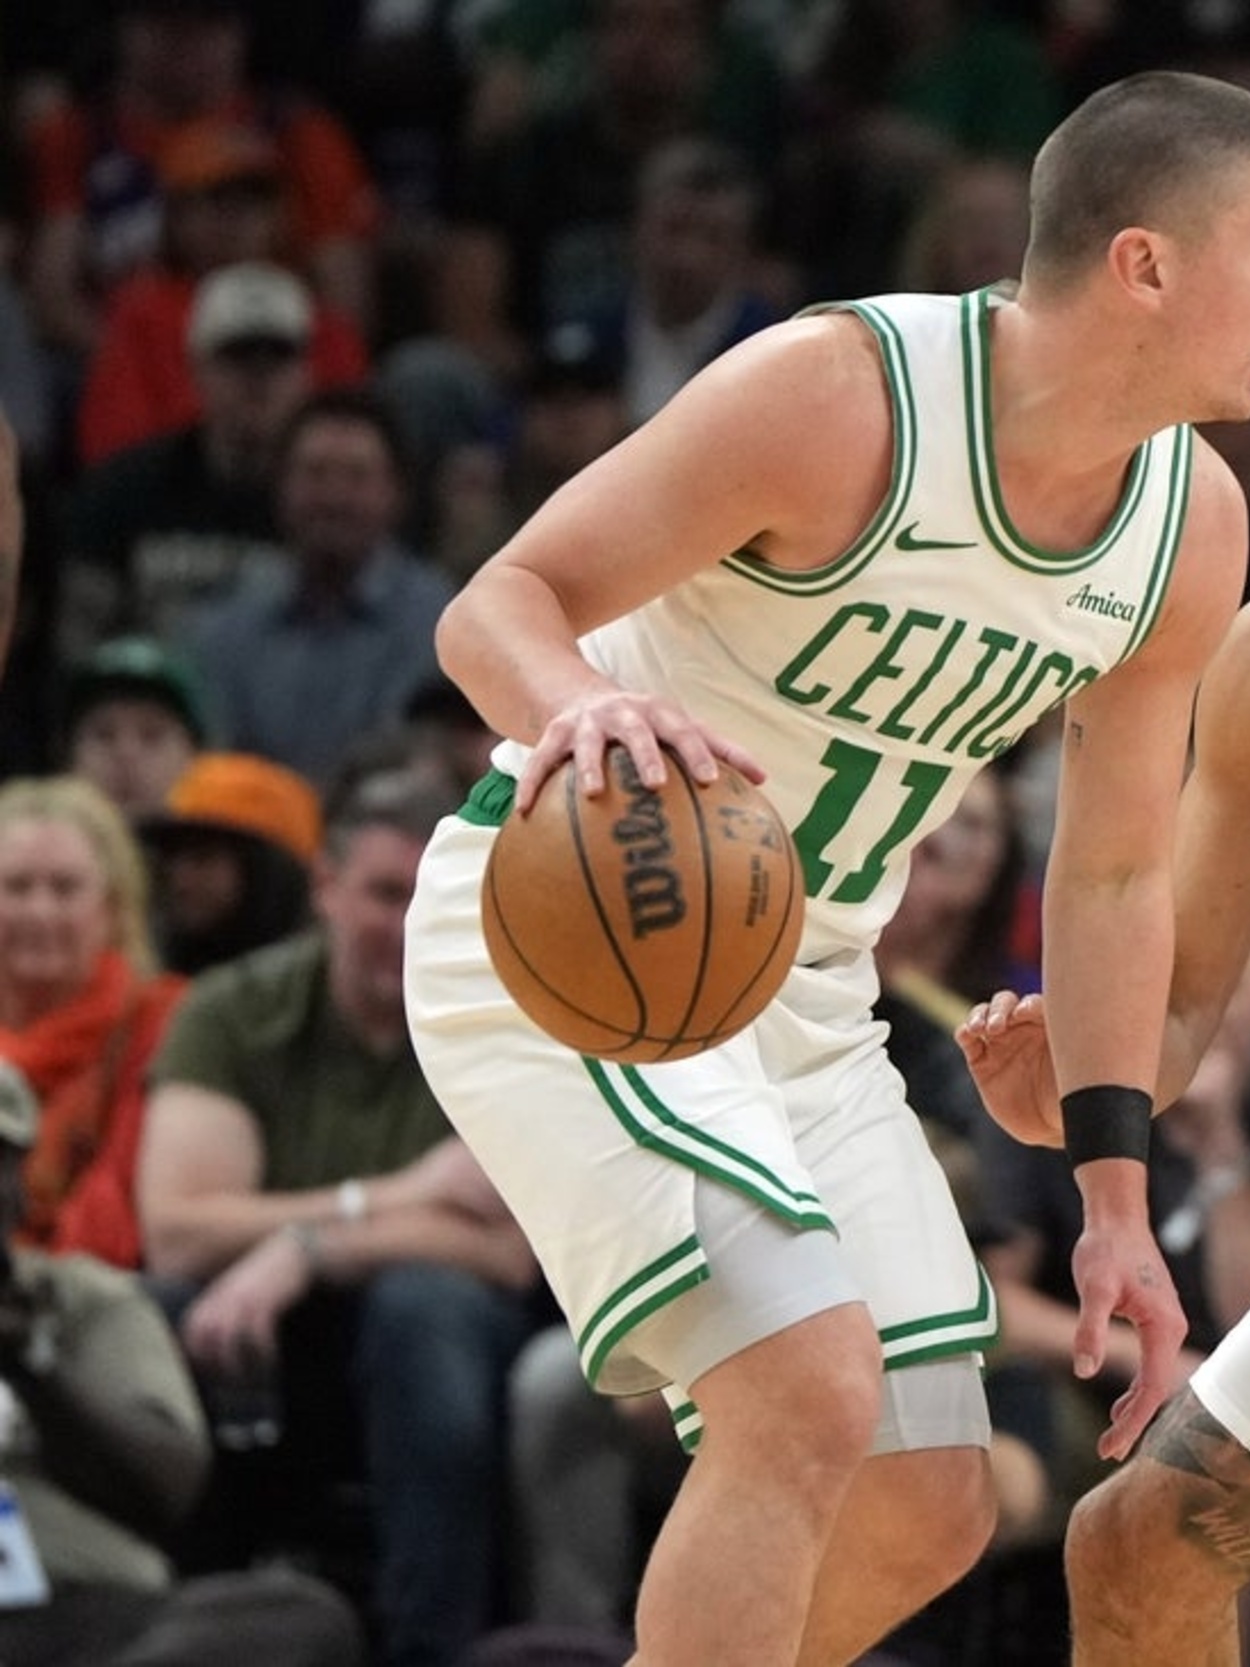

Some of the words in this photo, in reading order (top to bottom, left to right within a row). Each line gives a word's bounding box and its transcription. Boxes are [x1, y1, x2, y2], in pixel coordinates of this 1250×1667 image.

[1066, 583, 1135, 622] Amica
[611, 747, 687, 939] Wils
[791, 737, 953, 904] 11
